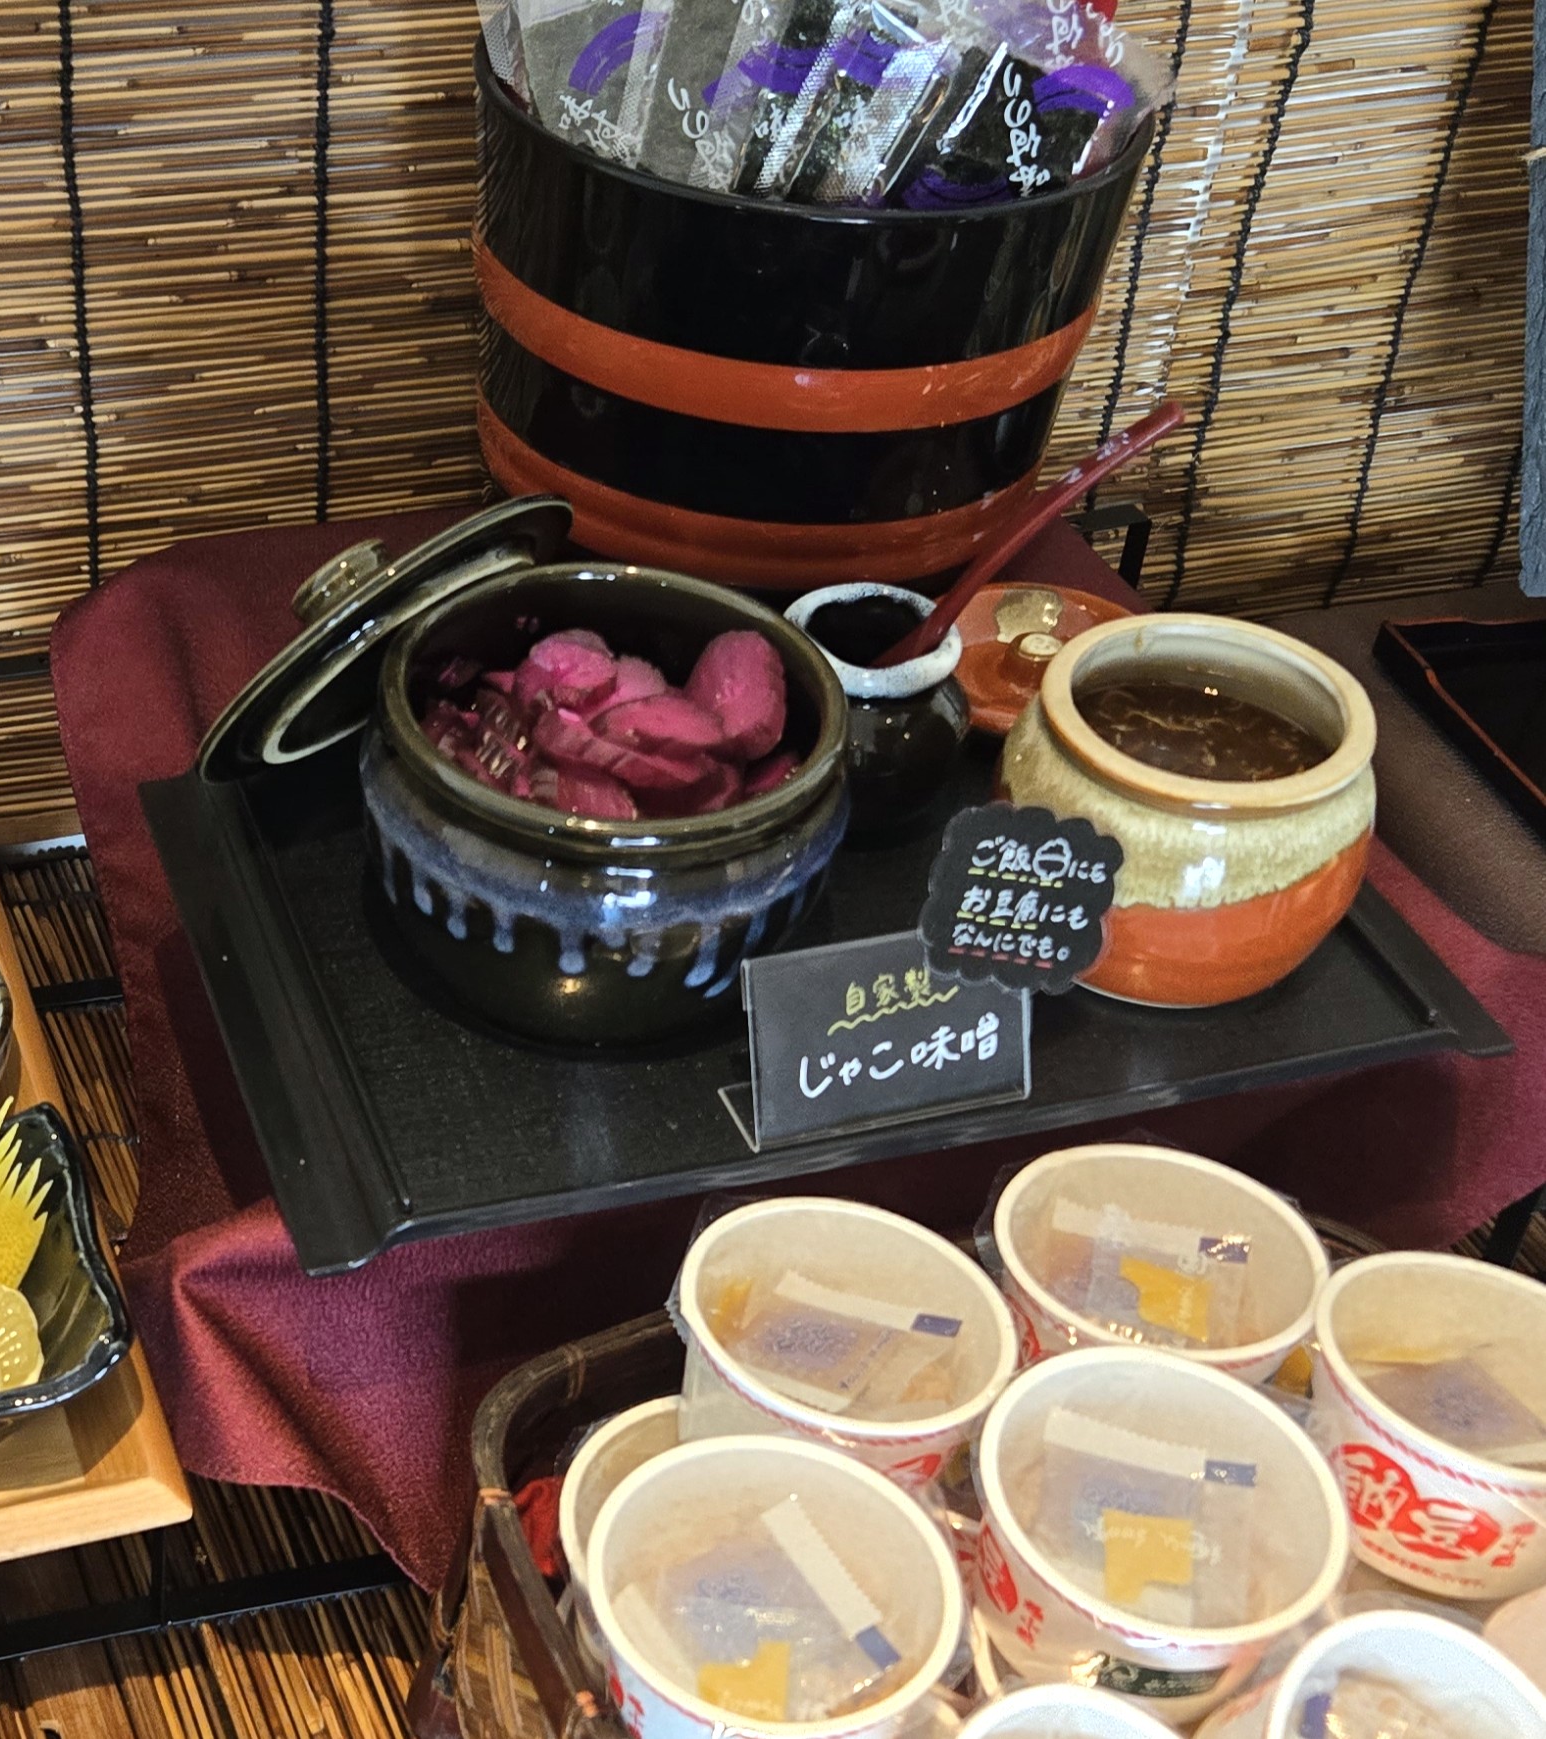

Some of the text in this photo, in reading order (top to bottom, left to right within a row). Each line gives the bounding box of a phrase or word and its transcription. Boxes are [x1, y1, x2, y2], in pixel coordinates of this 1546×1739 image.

[960, 885, 1089, 931] お豆腐にも
[846, 966, 931, 1016] 自家製
[799, 1011, 1000, 1099] じゃこ味噌
